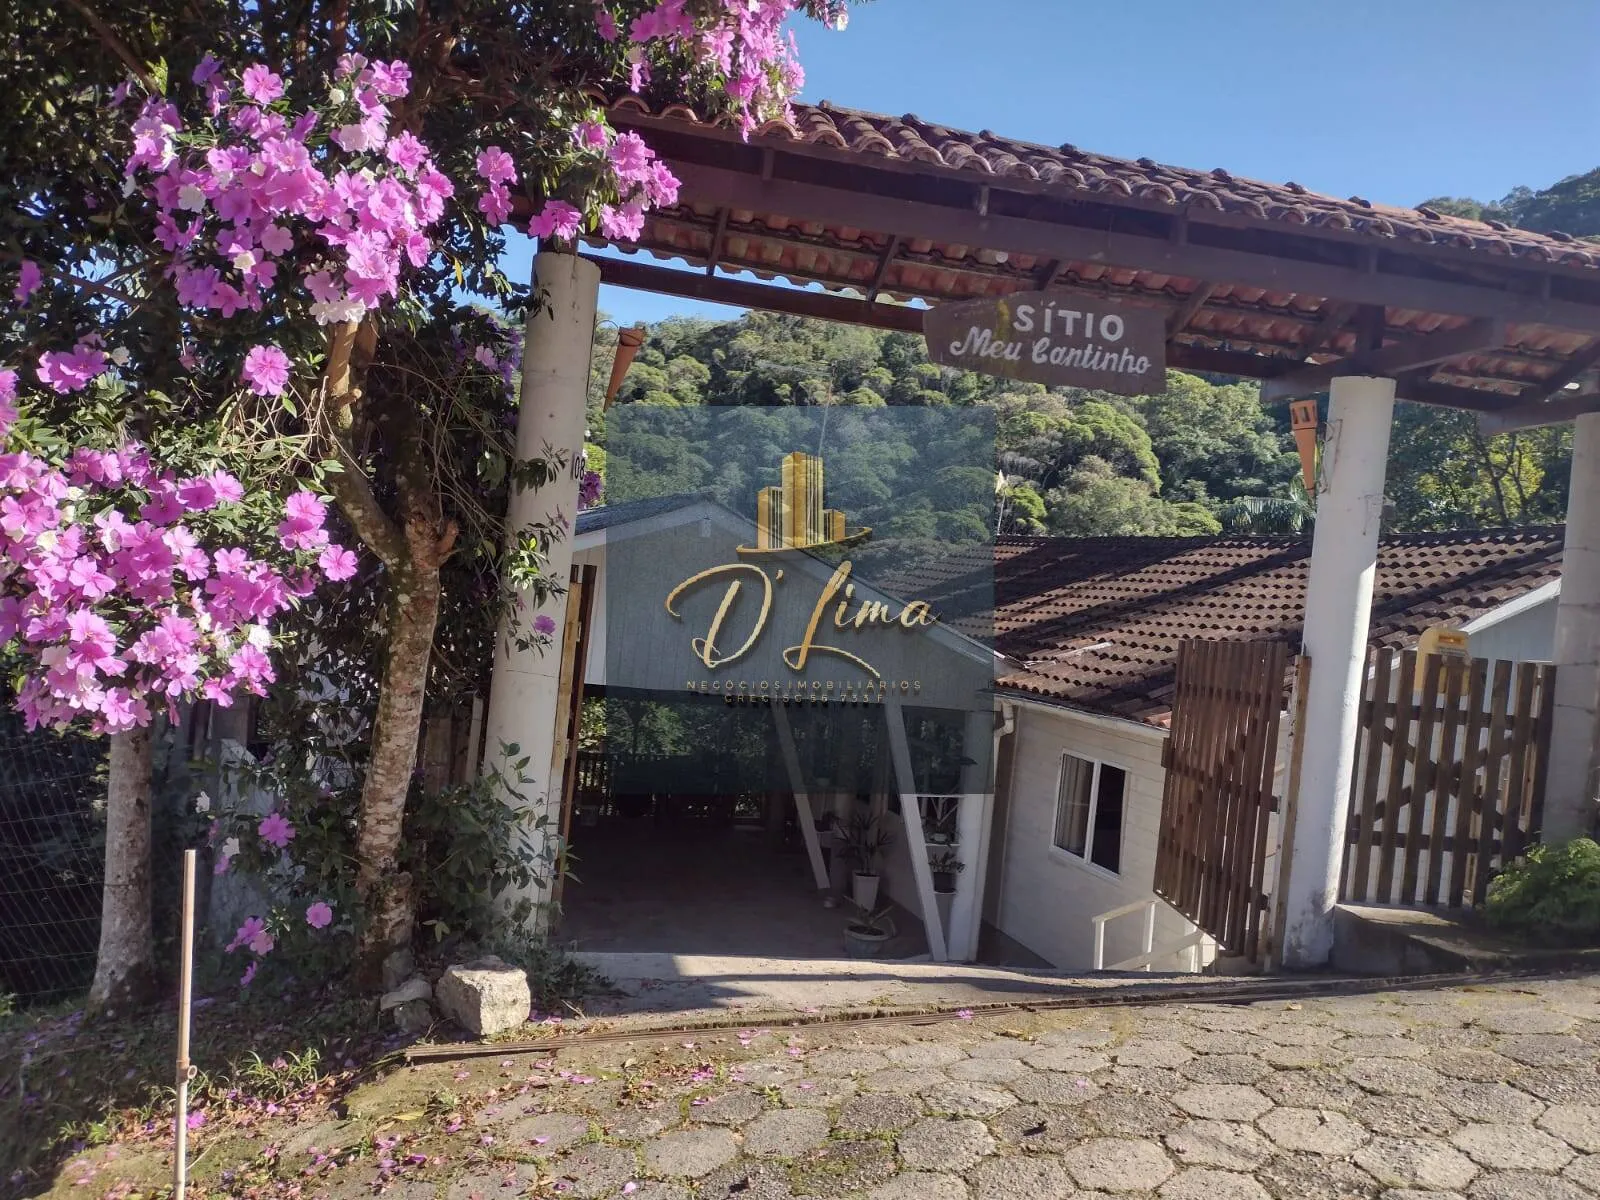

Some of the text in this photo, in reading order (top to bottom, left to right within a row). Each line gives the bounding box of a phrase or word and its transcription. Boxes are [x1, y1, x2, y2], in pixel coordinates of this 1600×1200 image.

[1012, 301, 1125, 342] SÍTIO
[949, 325, 1152, 375] Meu Cantinho
